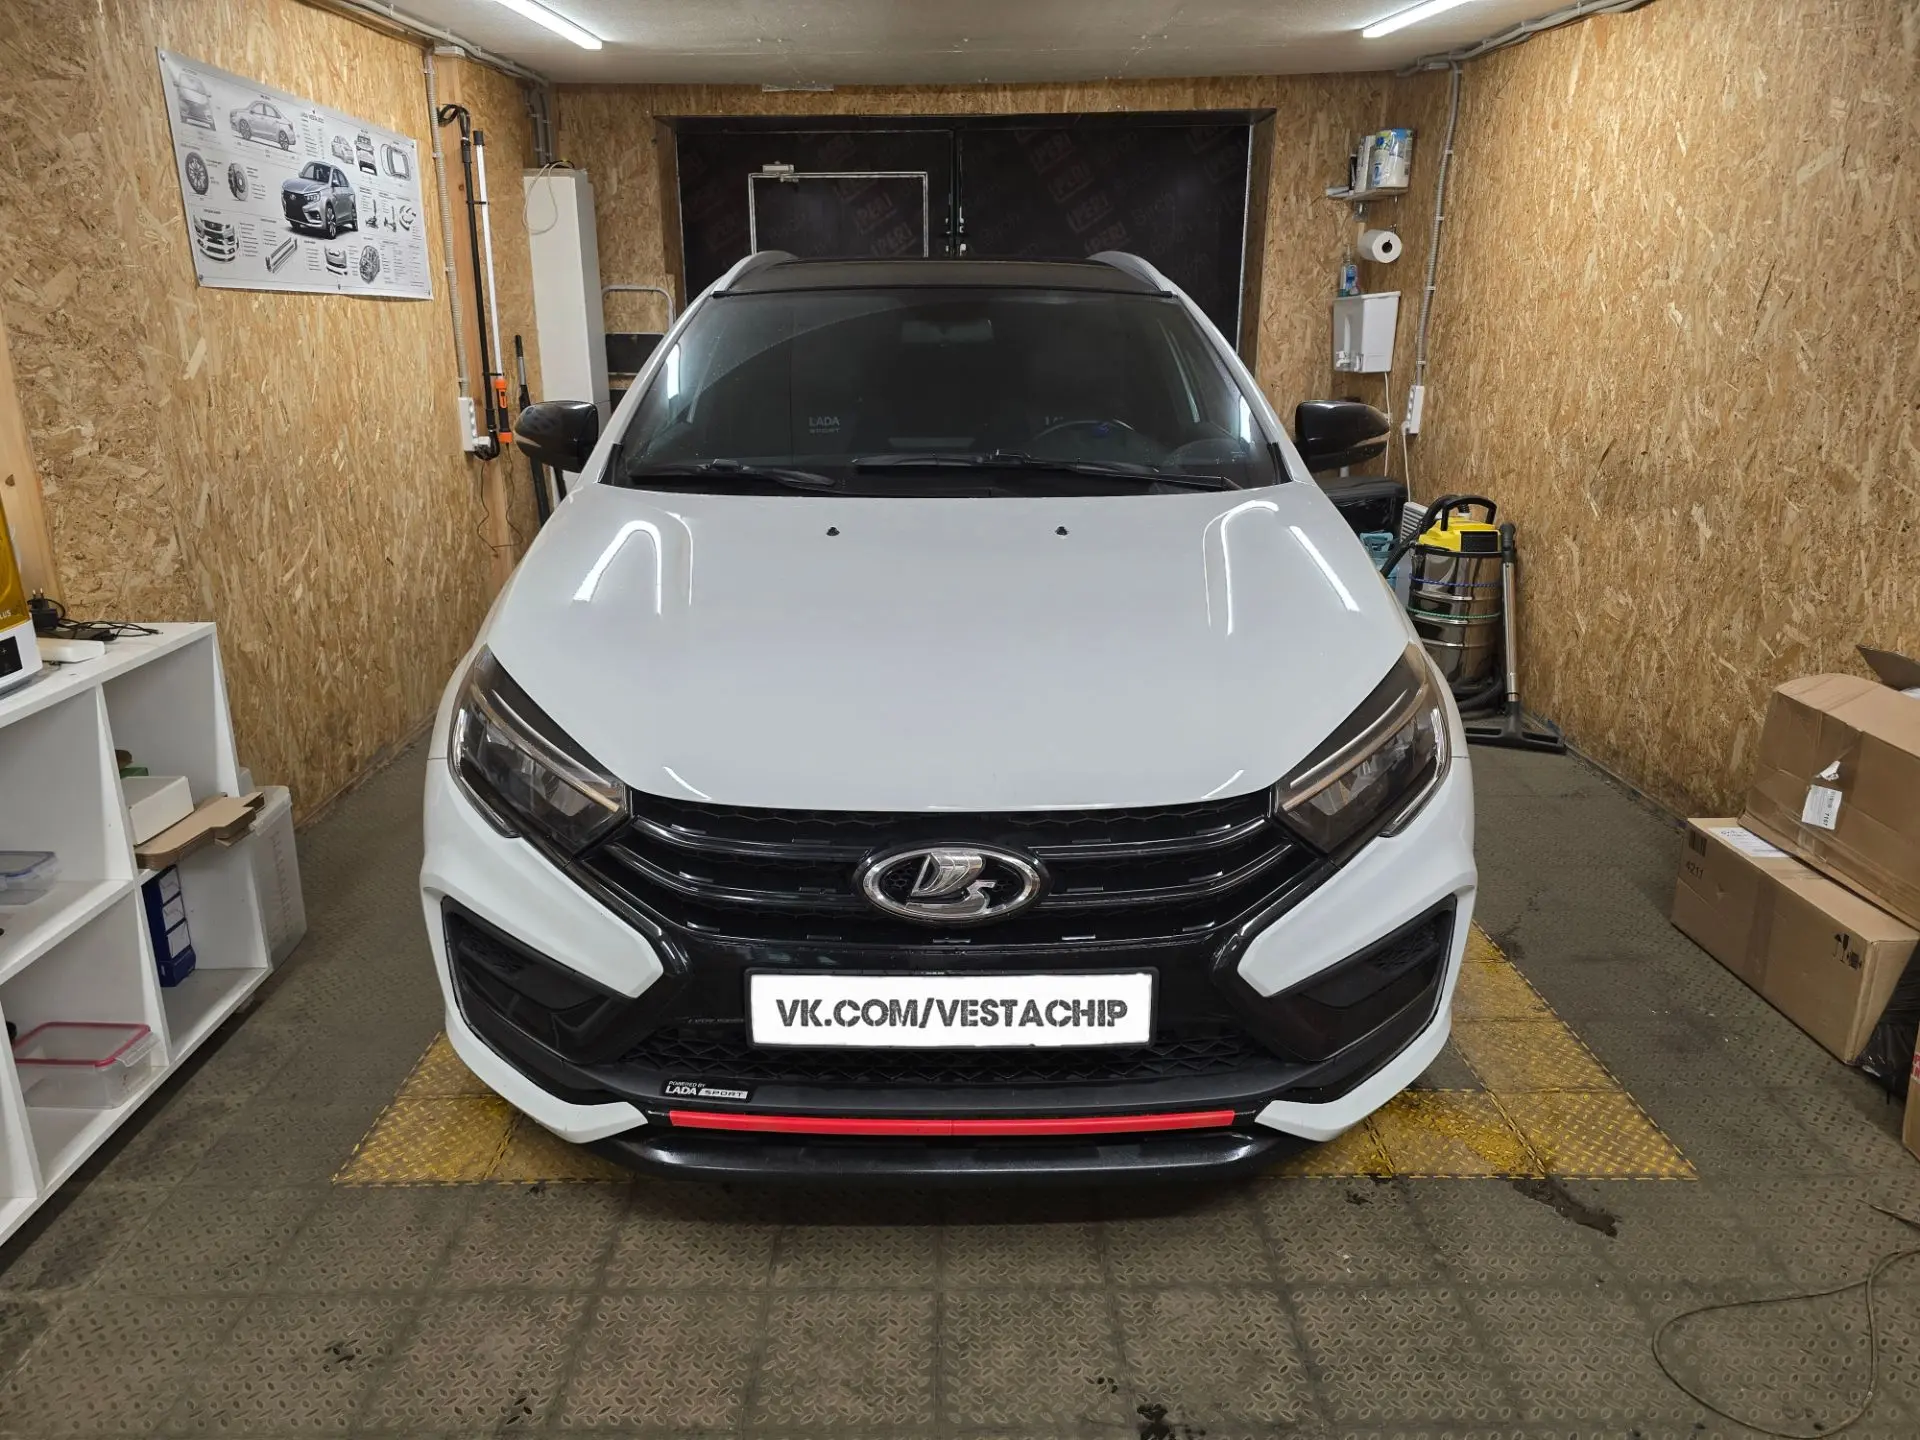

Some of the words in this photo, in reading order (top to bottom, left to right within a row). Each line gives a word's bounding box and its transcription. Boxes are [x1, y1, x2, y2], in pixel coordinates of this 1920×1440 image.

[1071, 191, 1109, 229] PERI
[808, 416, 840, 427] LADA
[775, 998, 1129, 1028] VK.COM/VESTACHIP
[665, 1085, 697, 1096] LADA
